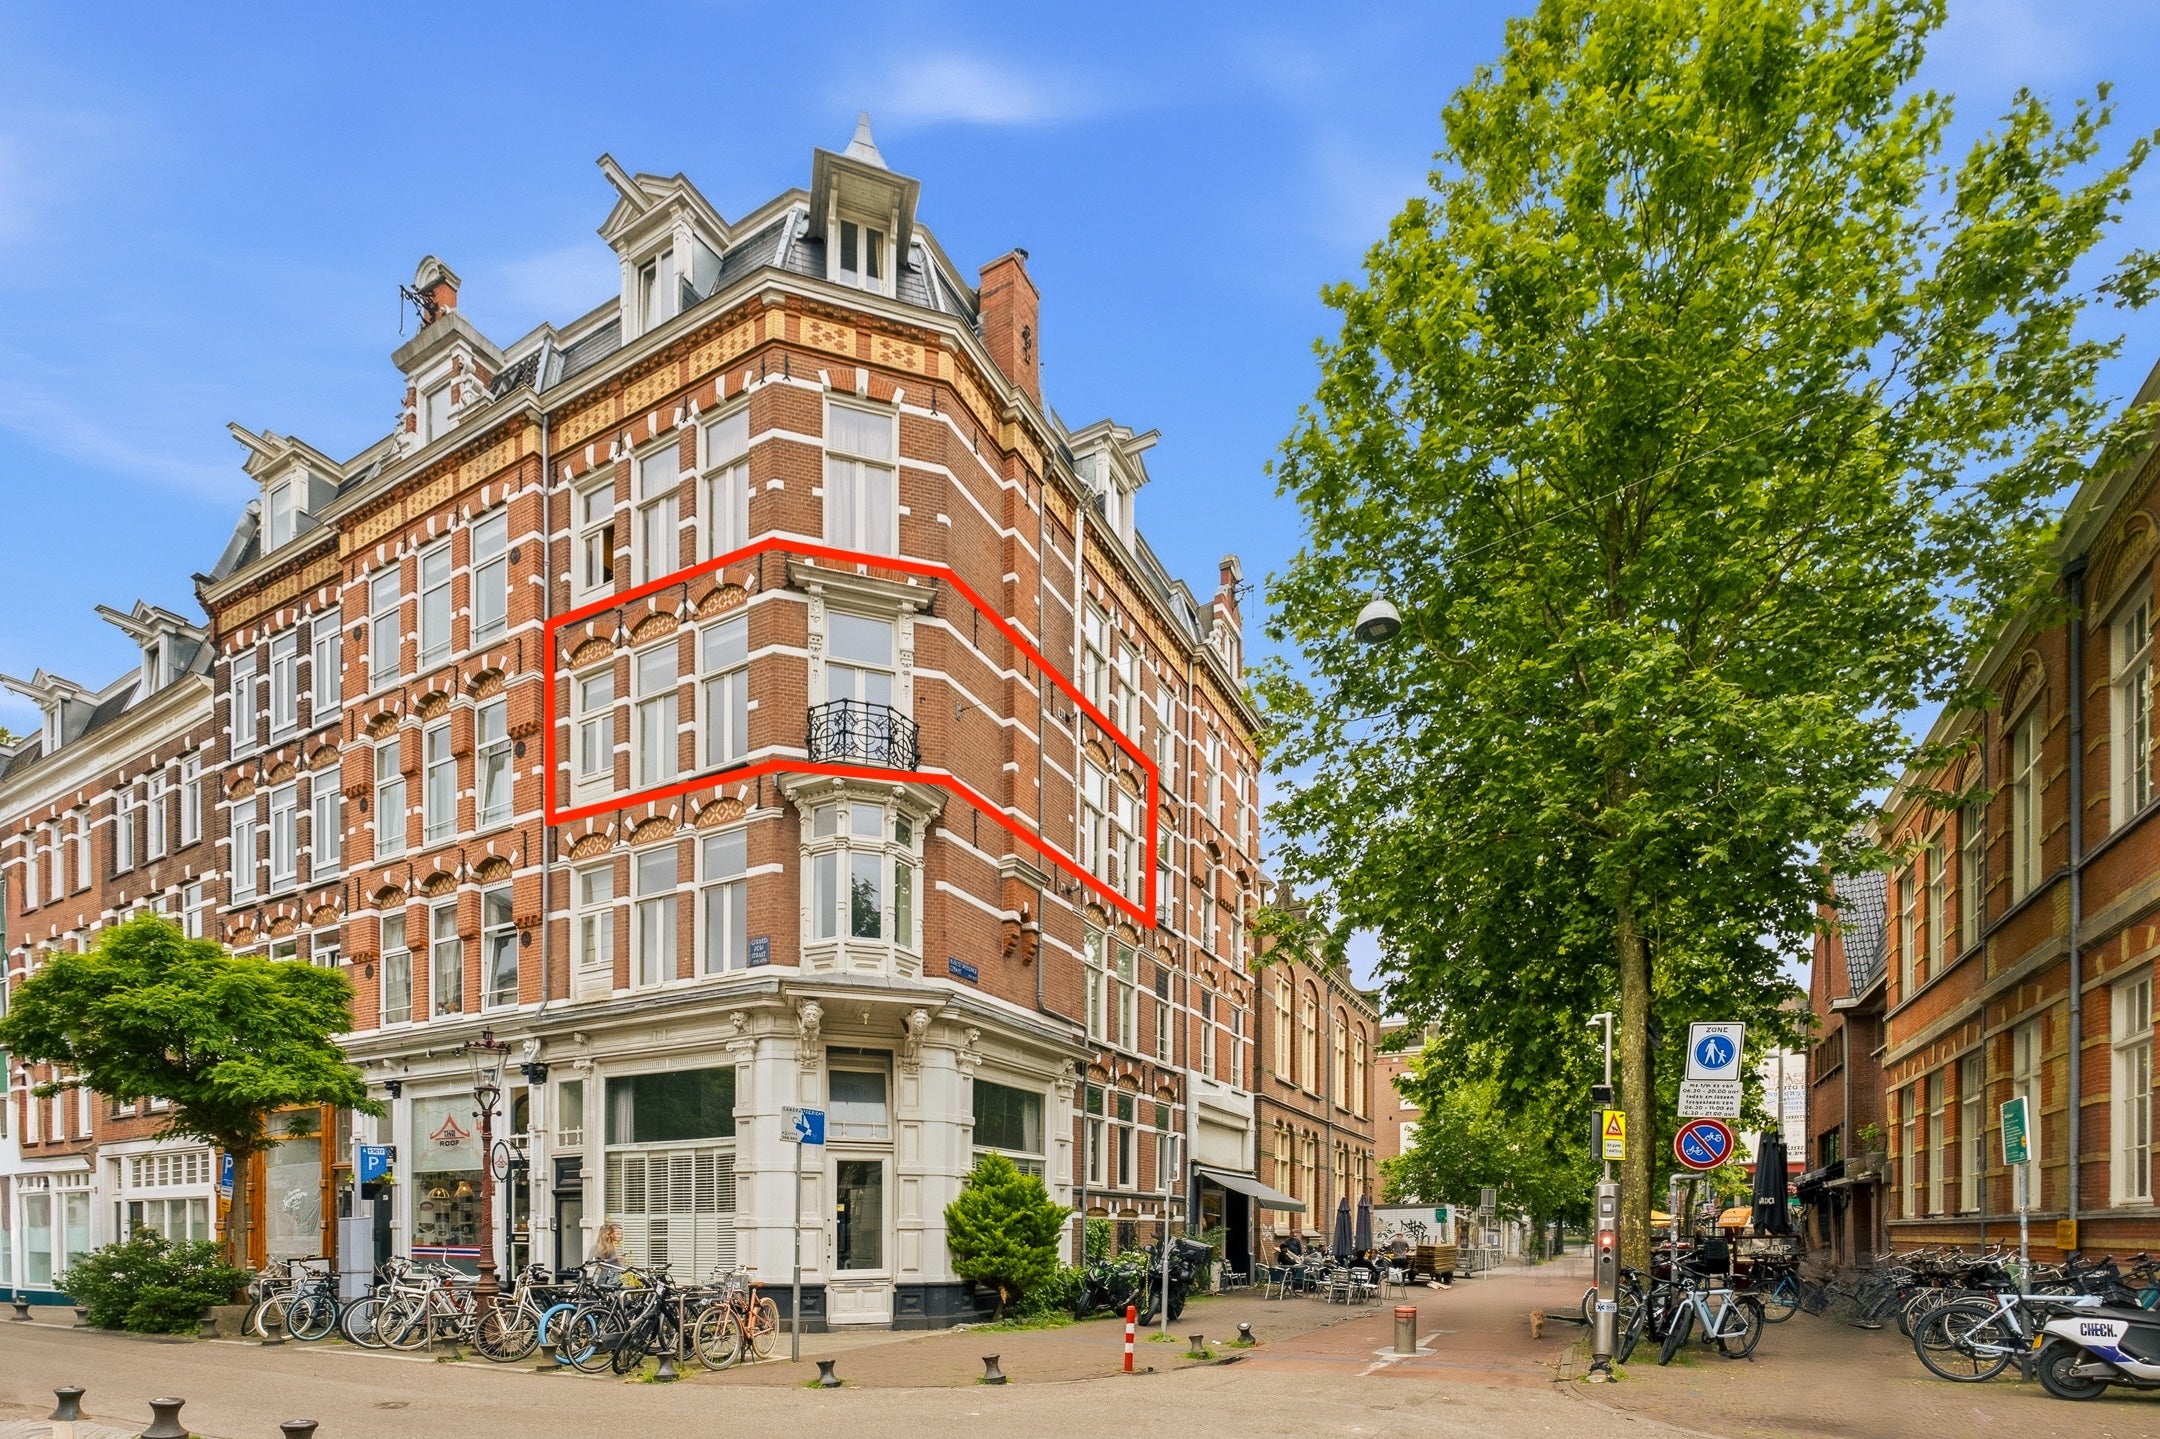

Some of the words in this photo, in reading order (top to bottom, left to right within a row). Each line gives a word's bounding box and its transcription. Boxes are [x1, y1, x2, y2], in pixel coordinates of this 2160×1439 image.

[439, 1139, 460, 1147] ROOF
[224, 1156, 234, 1174] P
[368, 1156, 380, 1171] P
[2080, 1322, 2118, 1337] CHECK.
